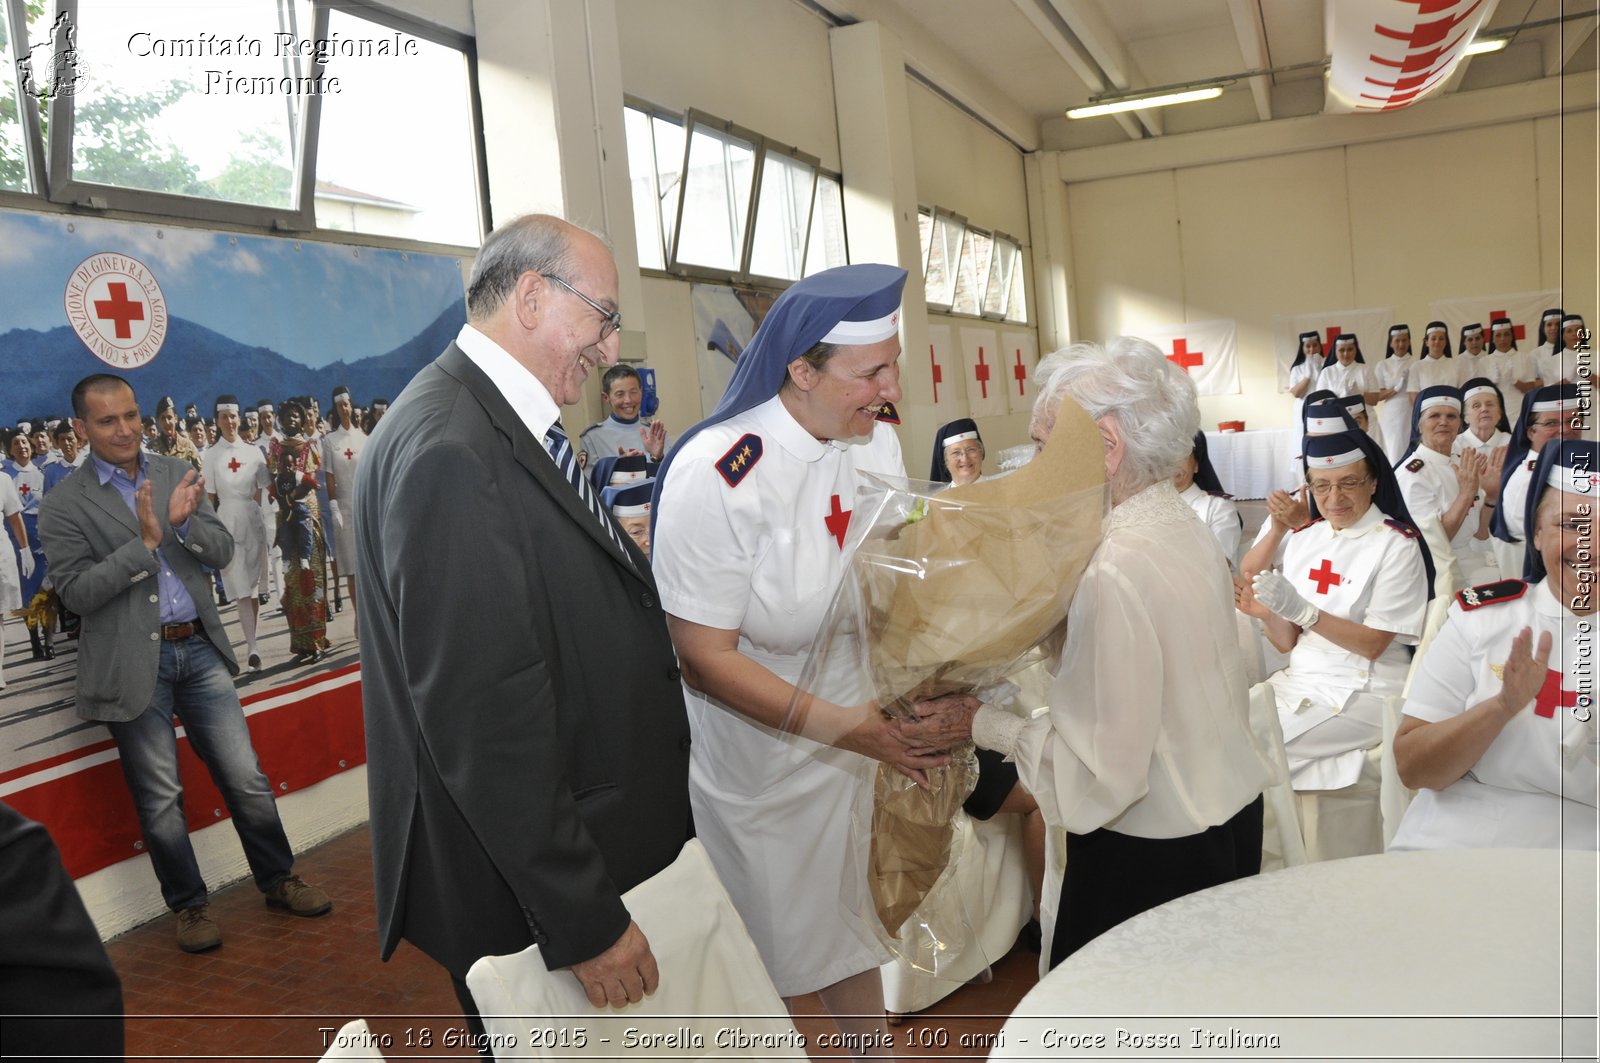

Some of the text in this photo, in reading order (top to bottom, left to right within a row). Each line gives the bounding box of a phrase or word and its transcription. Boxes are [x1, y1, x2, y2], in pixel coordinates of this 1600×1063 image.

[68, 256, 165, 363] CONVENZIONE DI GINEVRA 22 AGOSTO 1864
